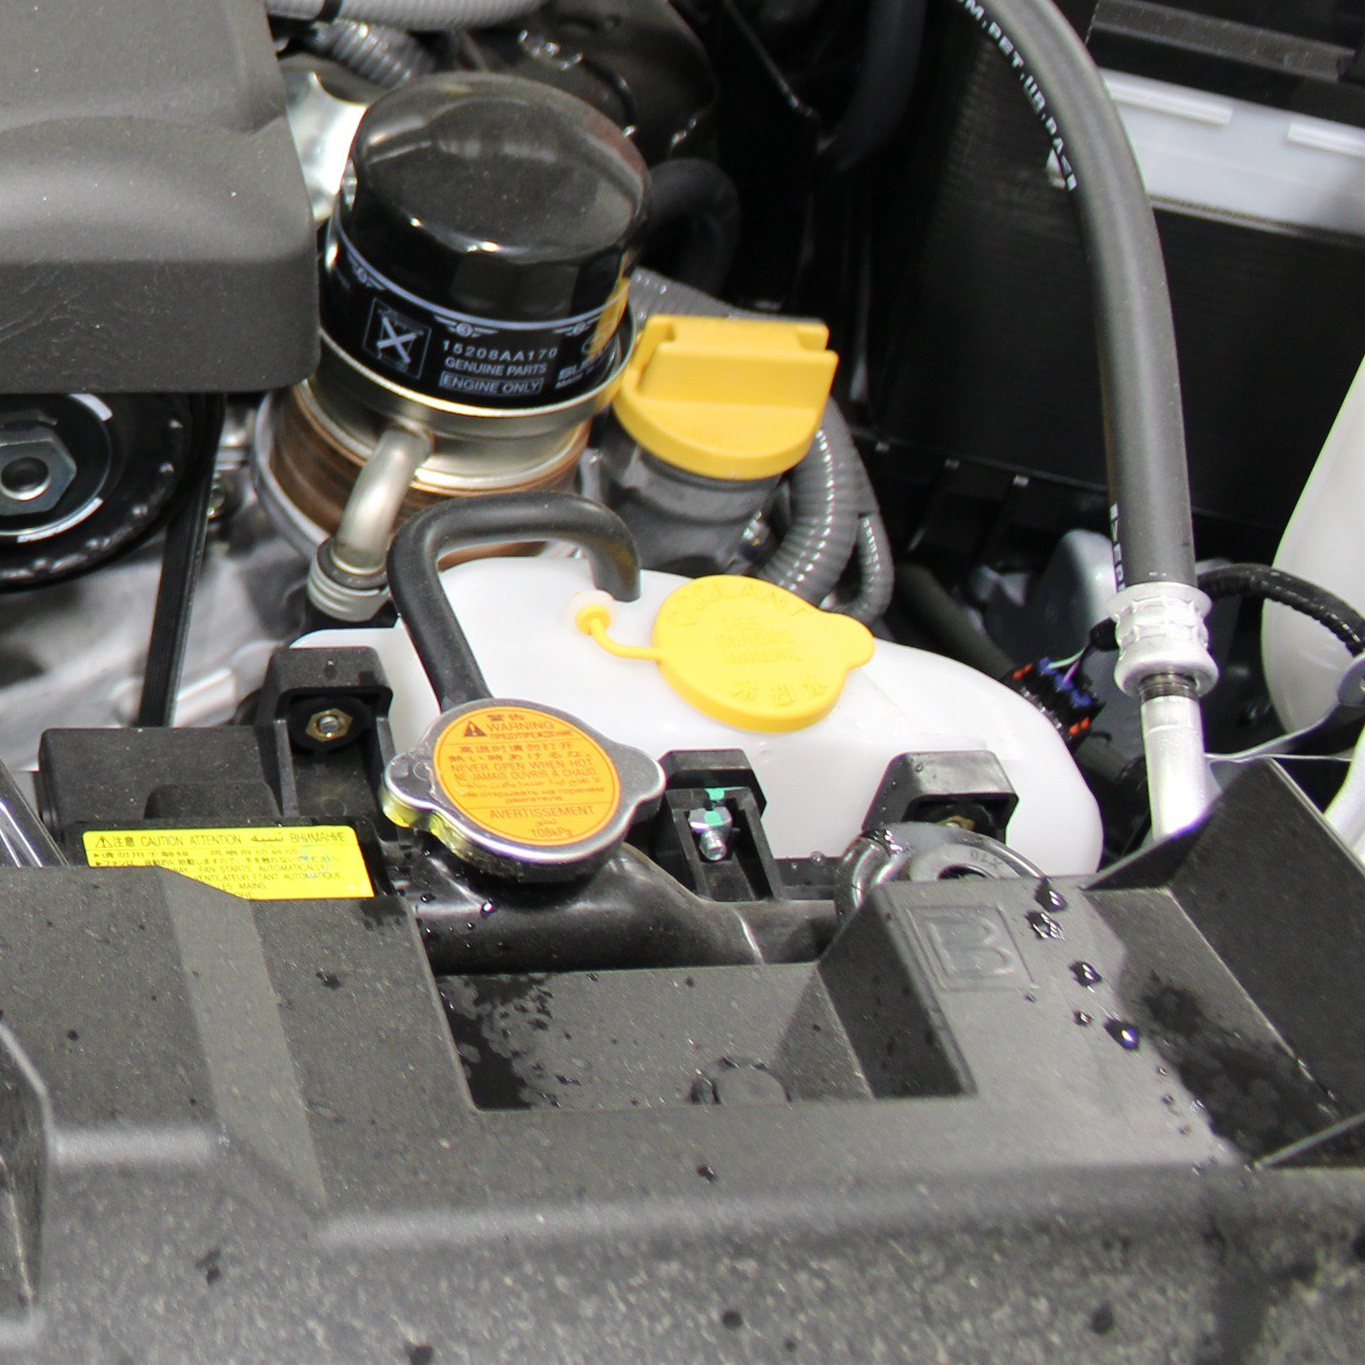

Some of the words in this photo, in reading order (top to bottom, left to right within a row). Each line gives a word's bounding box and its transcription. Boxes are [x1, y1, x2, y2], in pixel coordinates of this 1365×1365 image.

[444, 356, 504, 377] GENUINE
[506, 362, 548, 377] PARTS
[442, 374, 500, 393] ENGINE
[501, 379, 540, 395] ONLY
[668, 579, 813, 627] COOLANT
[487, 721, 554, 732] WARNING
[451, 763, 488, 773] NEVER
[494, 762, 526, 771] OPEN
[530, 760, 564, 769] WHEN
[455, 773, 466, 782] NE
[471, 772, 507, 781] JAMAIS
[510, 770, 548, 780] OUVRIR
[490, 806, 595, 819] AVERTISSEMENT
[140, 836, 183, 847] CAUTION
[190, 835, 242, 845] ATTENTION
[290, 832, 347, 844] ВНИМАНИЕ
